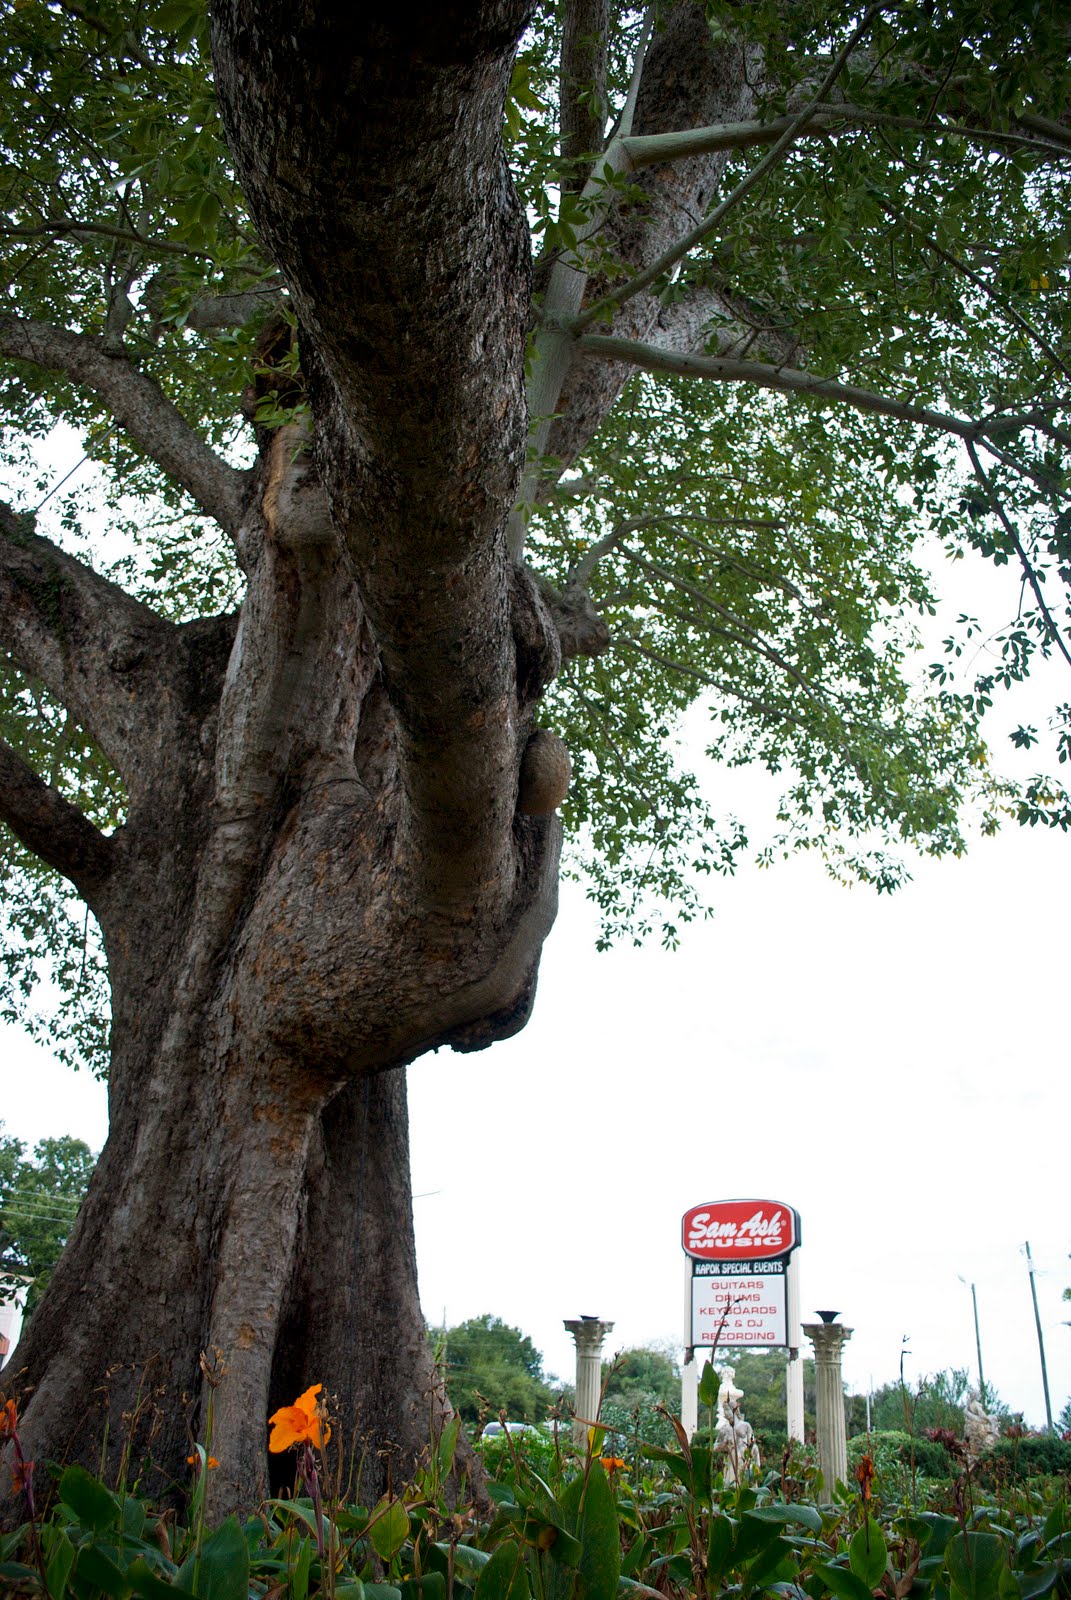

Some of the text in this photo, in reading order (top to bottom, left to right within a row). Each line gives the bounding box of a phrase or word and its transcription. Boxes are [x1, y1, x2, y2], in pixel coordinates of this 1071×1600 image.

[688, 1210, 783, 1239] Sam Ash
[689, 1236, 783, 1248] MUSIC
[695, 1261, 784, 1275] KAPOK SPECIAL EVENTS
[711, 1281, 764, 1290] GUITARS
[715, 1294, 761, 1302] DRUMS
[699, 1306, 777, 1315] KEYBOARDS
[734, 1319, 743, 1328] &
[747, 1319, 763, 1328] DJ
[701, 1332, 776, 1340] RECORDING
